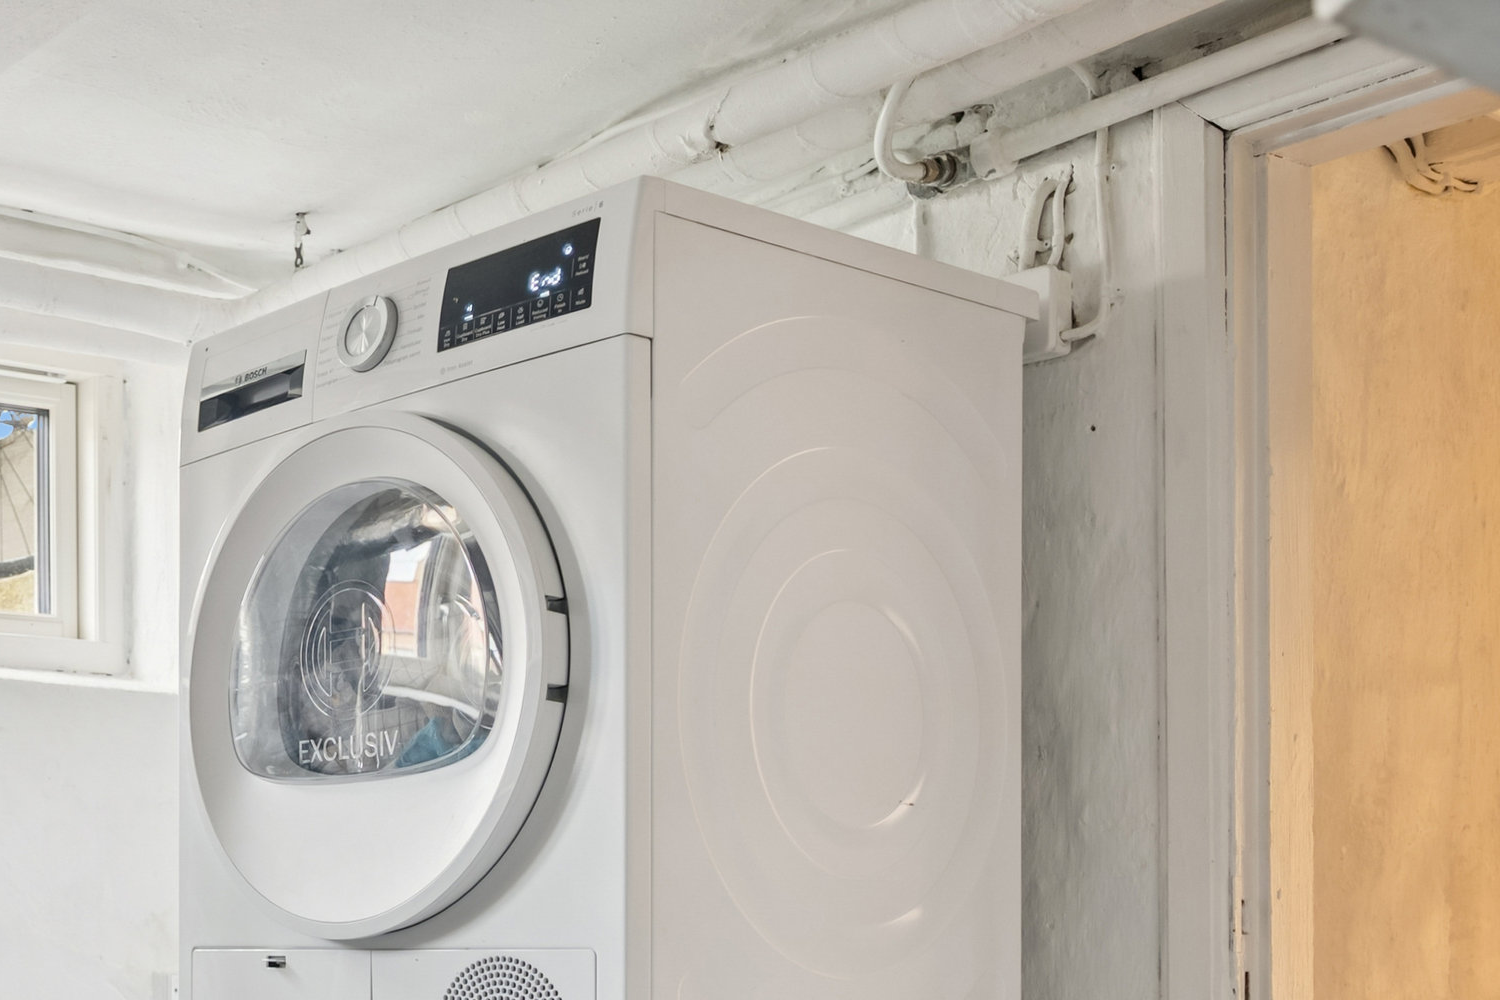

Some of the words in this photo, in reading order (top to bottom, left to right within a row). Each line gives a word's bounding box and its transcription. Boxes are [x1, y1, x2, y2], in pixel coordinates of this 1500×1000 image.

[529, 268, 562, 292] End
[244, 366, 267, 382] BOSCH
[299, 730, 398, 764] EXCLUSIV
